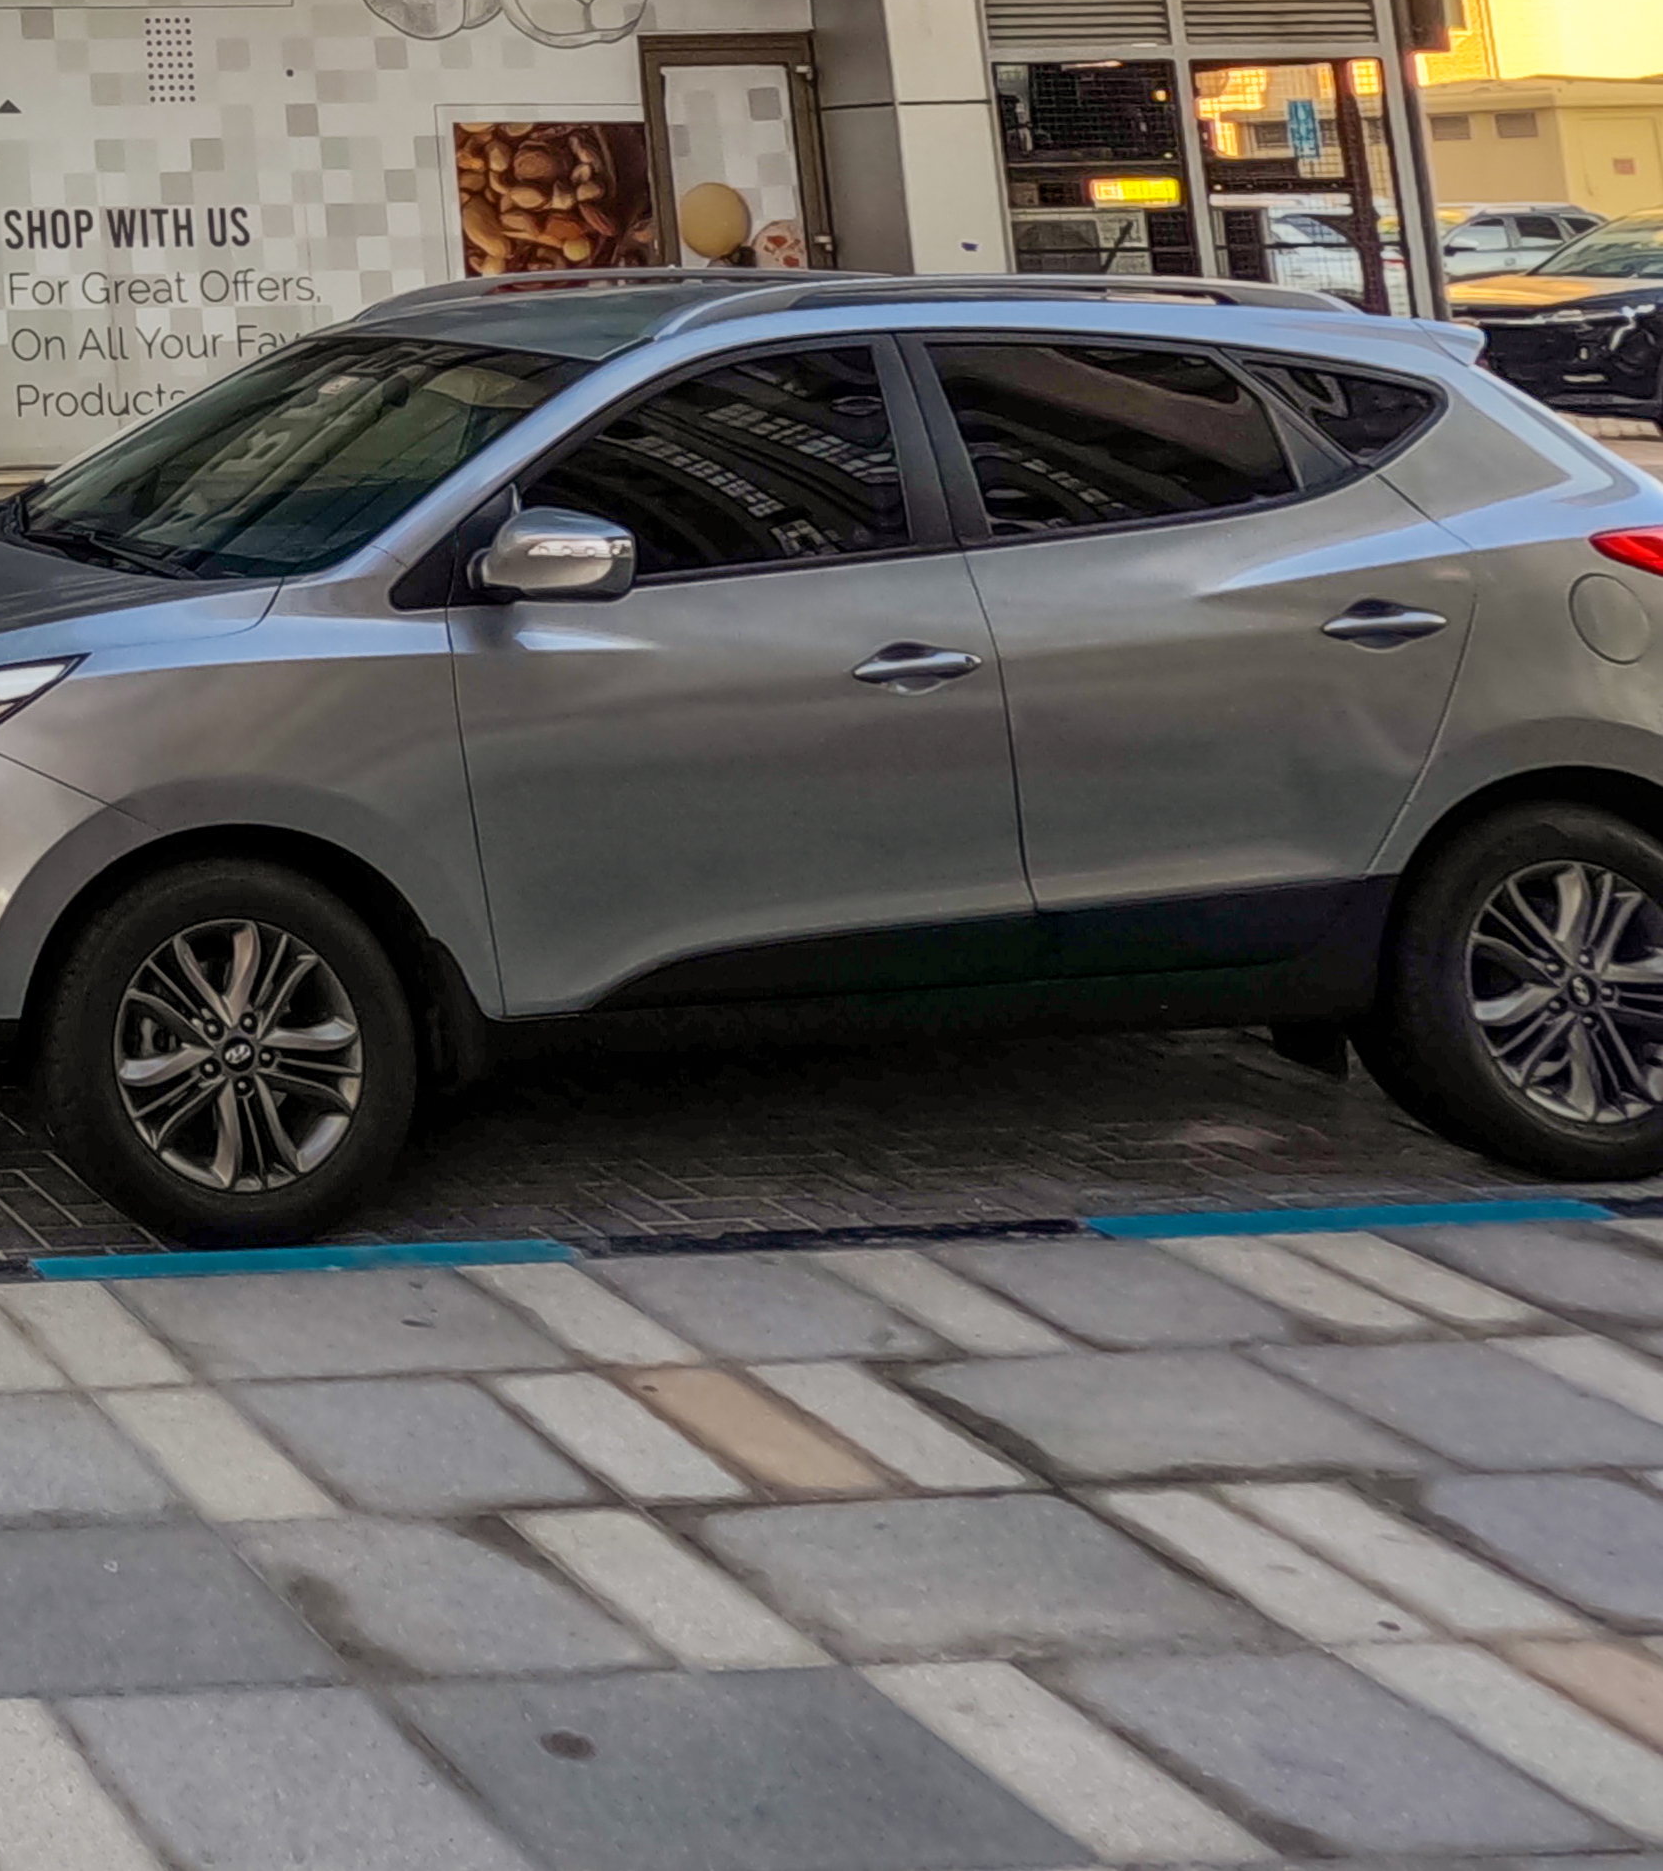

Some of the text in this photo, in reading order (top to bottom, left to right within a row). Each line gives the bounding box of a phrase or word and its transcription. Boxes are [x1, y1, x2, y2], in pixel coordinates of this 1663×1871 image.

[4, 206, 251, 249] SHOP WITH US
[9, 272, 69, 306] For
[81, 271, 189, 305] Great
[11, 327, 67, 362] On
[78, 326, 130, 361] All
[135, 326, 225, 360] Your
